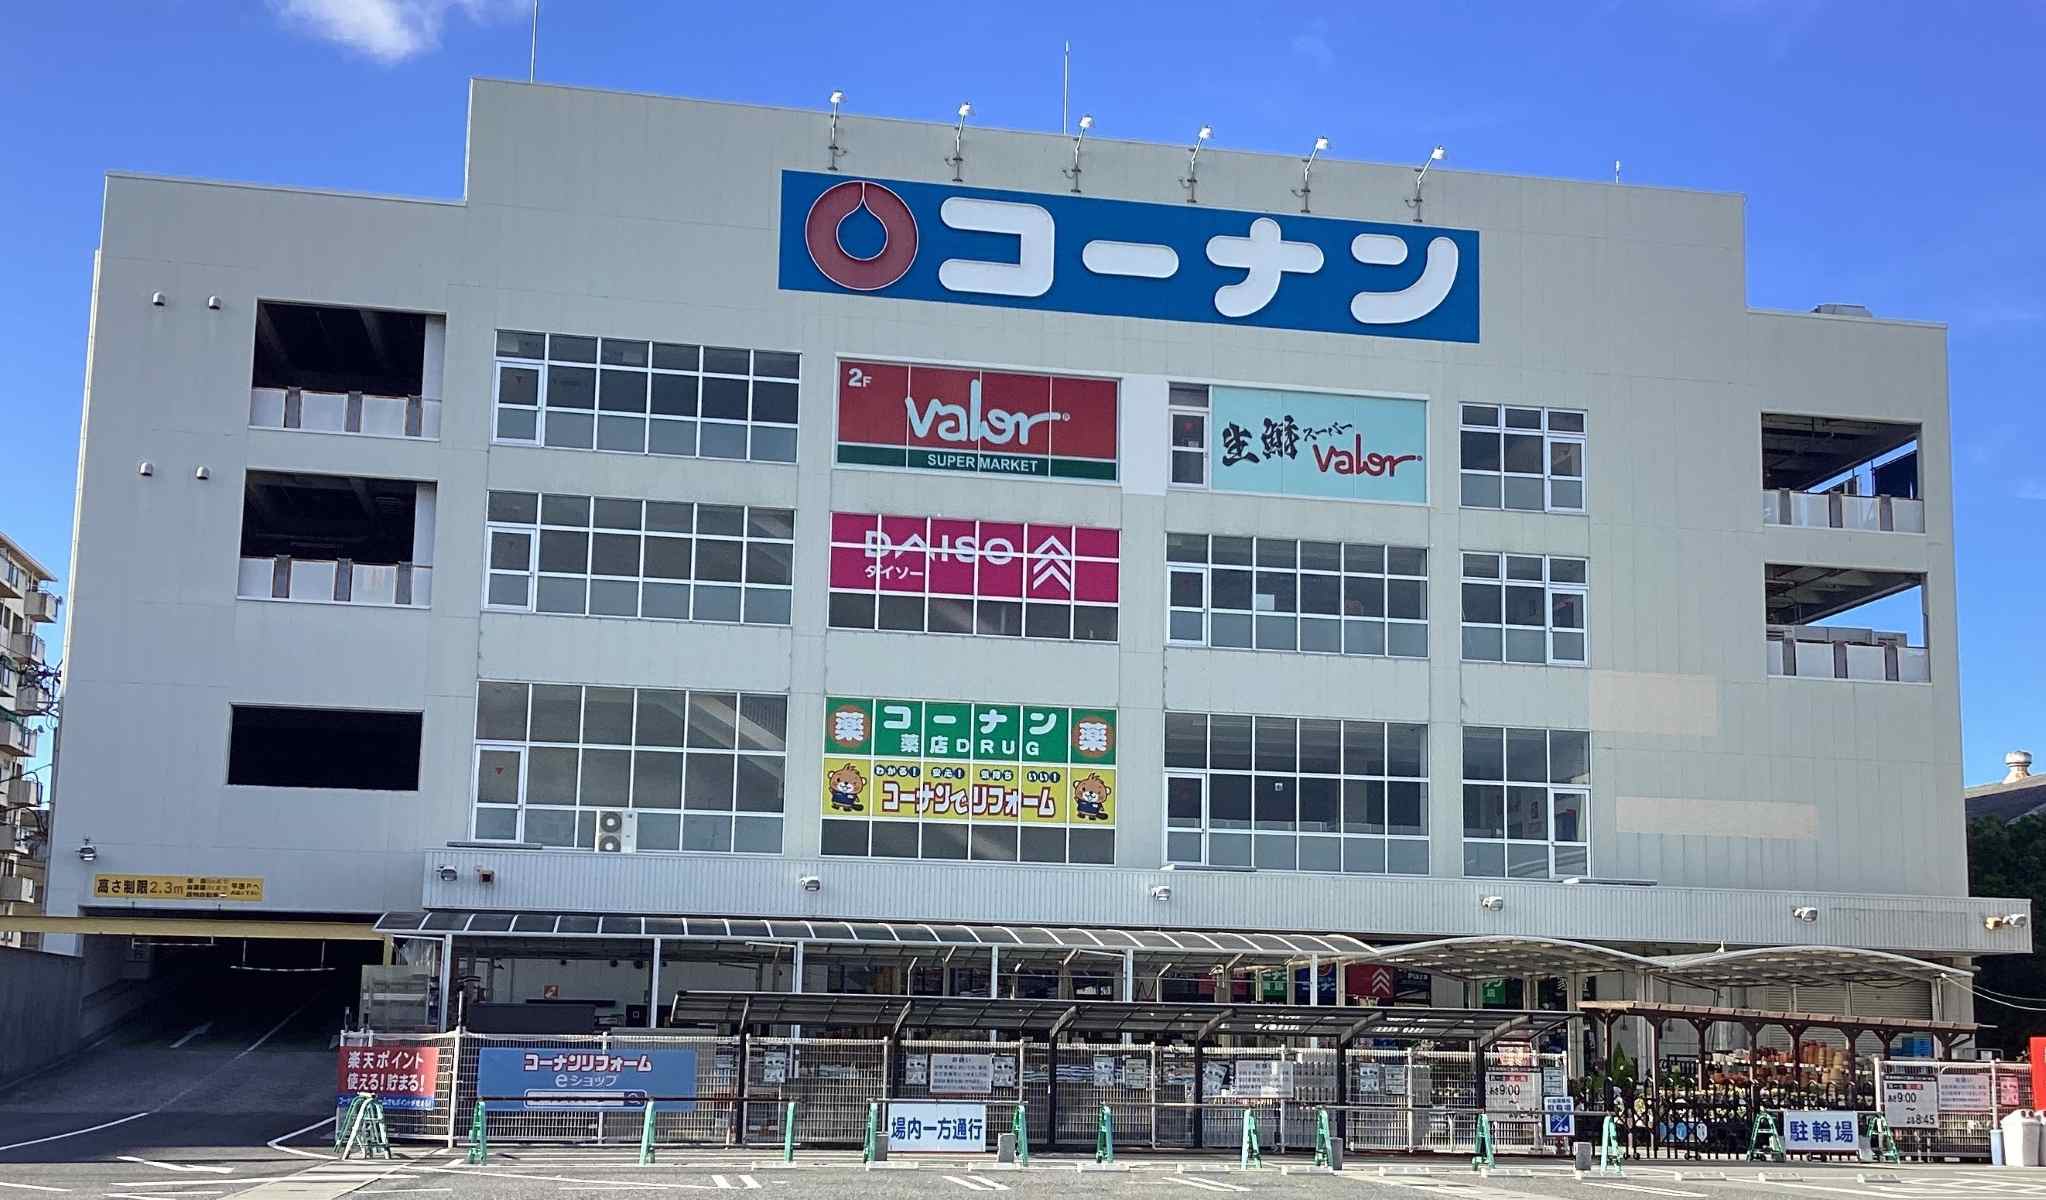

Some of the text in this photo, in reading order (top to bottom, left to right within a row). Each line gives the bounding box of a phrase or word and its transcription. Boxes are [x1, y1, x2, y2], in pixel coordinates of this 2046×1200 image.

[939, 197, 1458, 324] コーナン
[848, 368, 872, 388] 2F
[927, 454, 1038, 473] SUPER MARKET
[864, 530, 1015, 564] DAISO
[864, 564, 924, 580] ダイソー
[834, 711, 864, 741] 薬
[883, 705, 1057, 735] コーナン
[1079, 721, 1107, 751] 薬
[882, 781, 1056, 817] コーナンでリフォーム
[347, 1050, 424, 1070] 楽天ポイント
[524, 1053, 652, 1072] コーナンリフォーム
[555, 1074, 617, 1087] eショップ
[890, 1116, 983, 1141] 場内一方通行
[1789, 1120, 1854, 1143] 駐輪場
